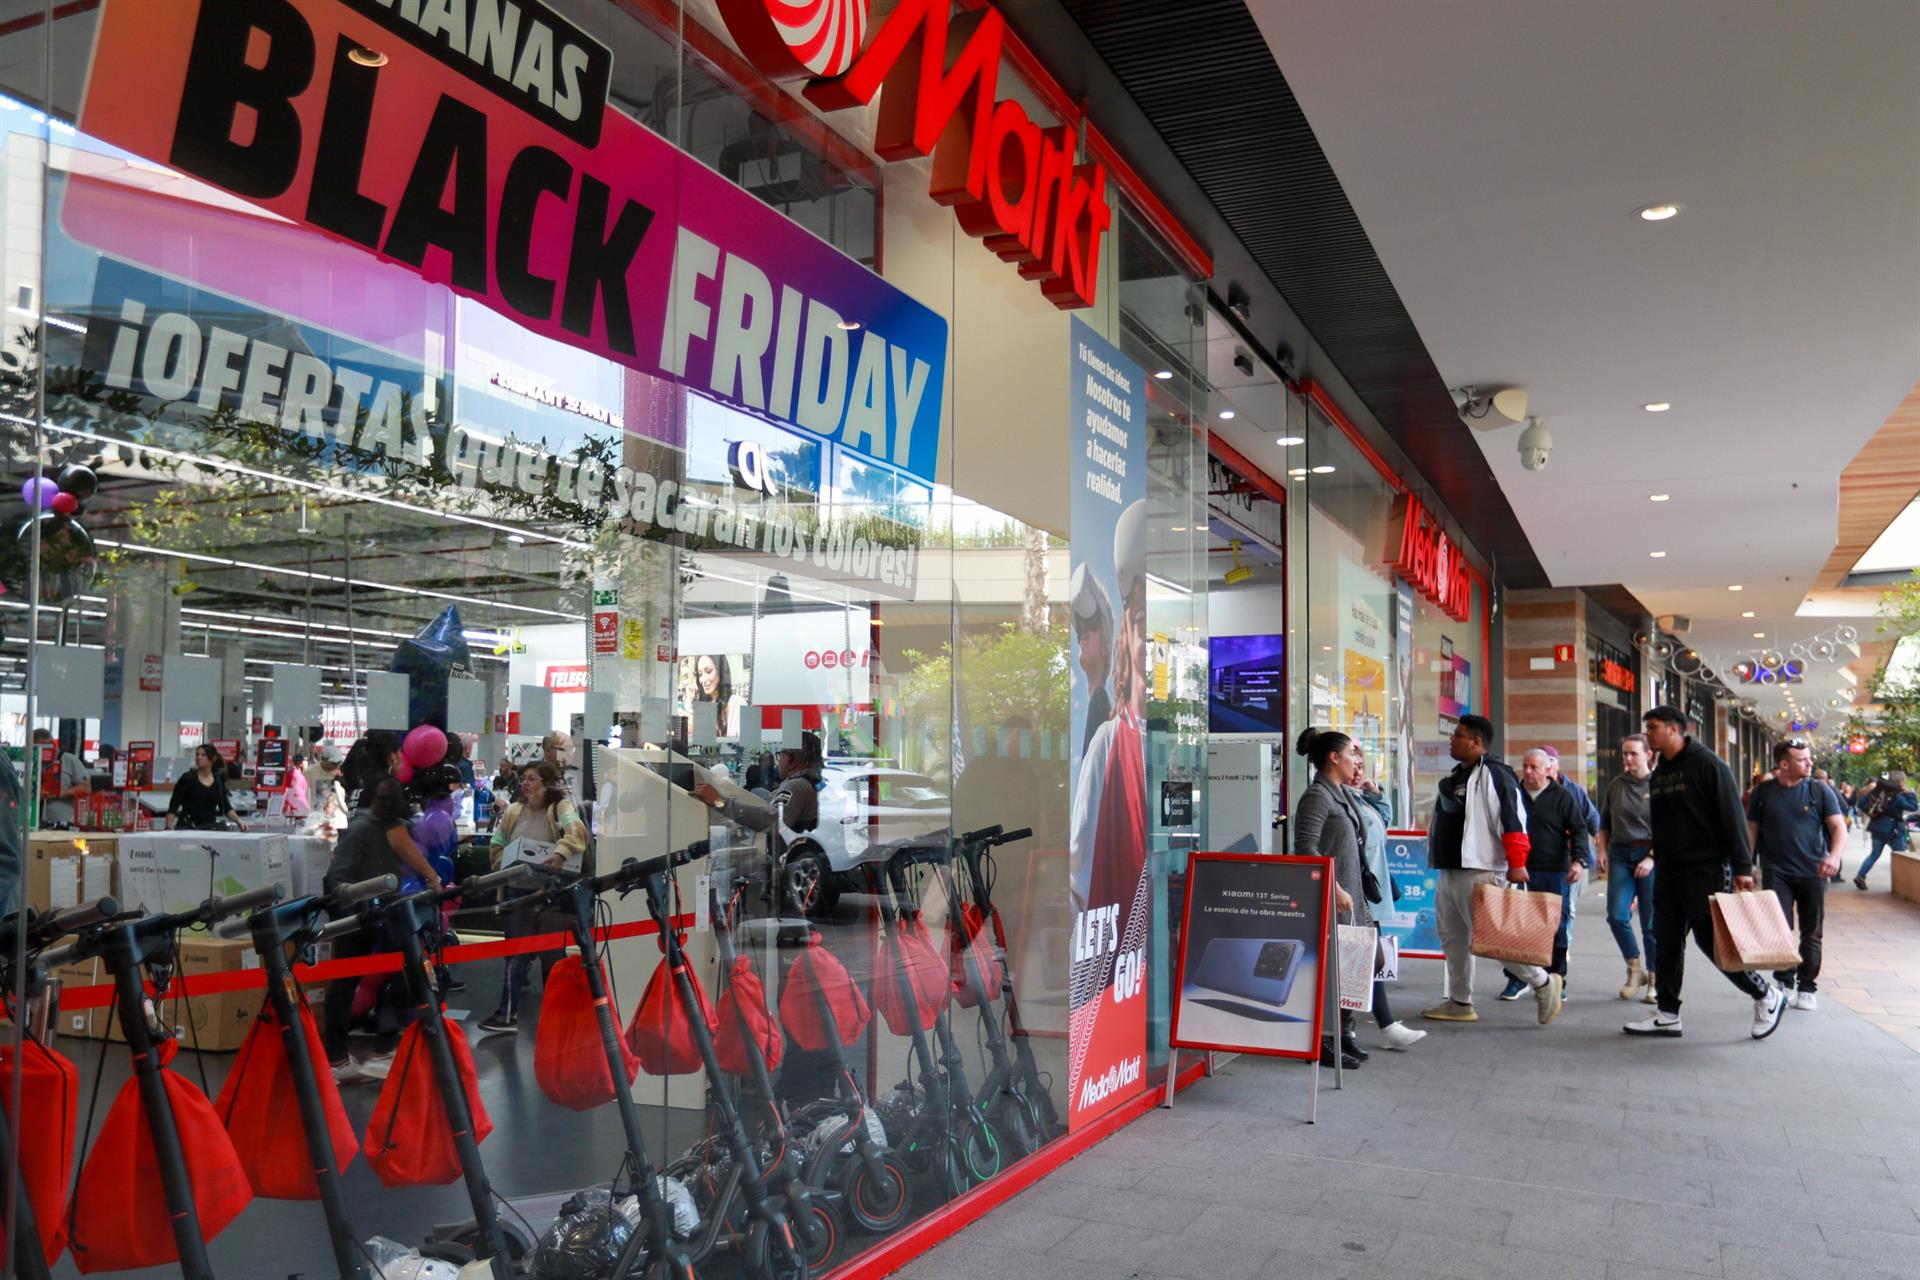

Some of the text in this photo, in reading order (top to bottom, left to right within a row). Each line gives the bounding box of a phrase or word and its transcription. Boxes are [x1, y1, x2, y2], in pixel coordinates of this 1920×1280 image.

[843, 0, 1111, 307] Markt
[169, 0, 931, 471] BLACK FRIDAY
[1086, 374, 1131, 422] Nosotros te
[1086, 408, 1128, 449] ayudamos
[1086, 439, 1126, 477] a hacerlas
[1086, 470, 1122, 504] realidad.
[763, 505, 808, 562] los
[813, 519, 916, 590] colores!
[1075, 903, 1120, 962] LET'S
[1213, 906, 1239, 914] esencia
[1259, 909, 1276, 917] obra
[1114, 949, 1142, 1003] GO!
